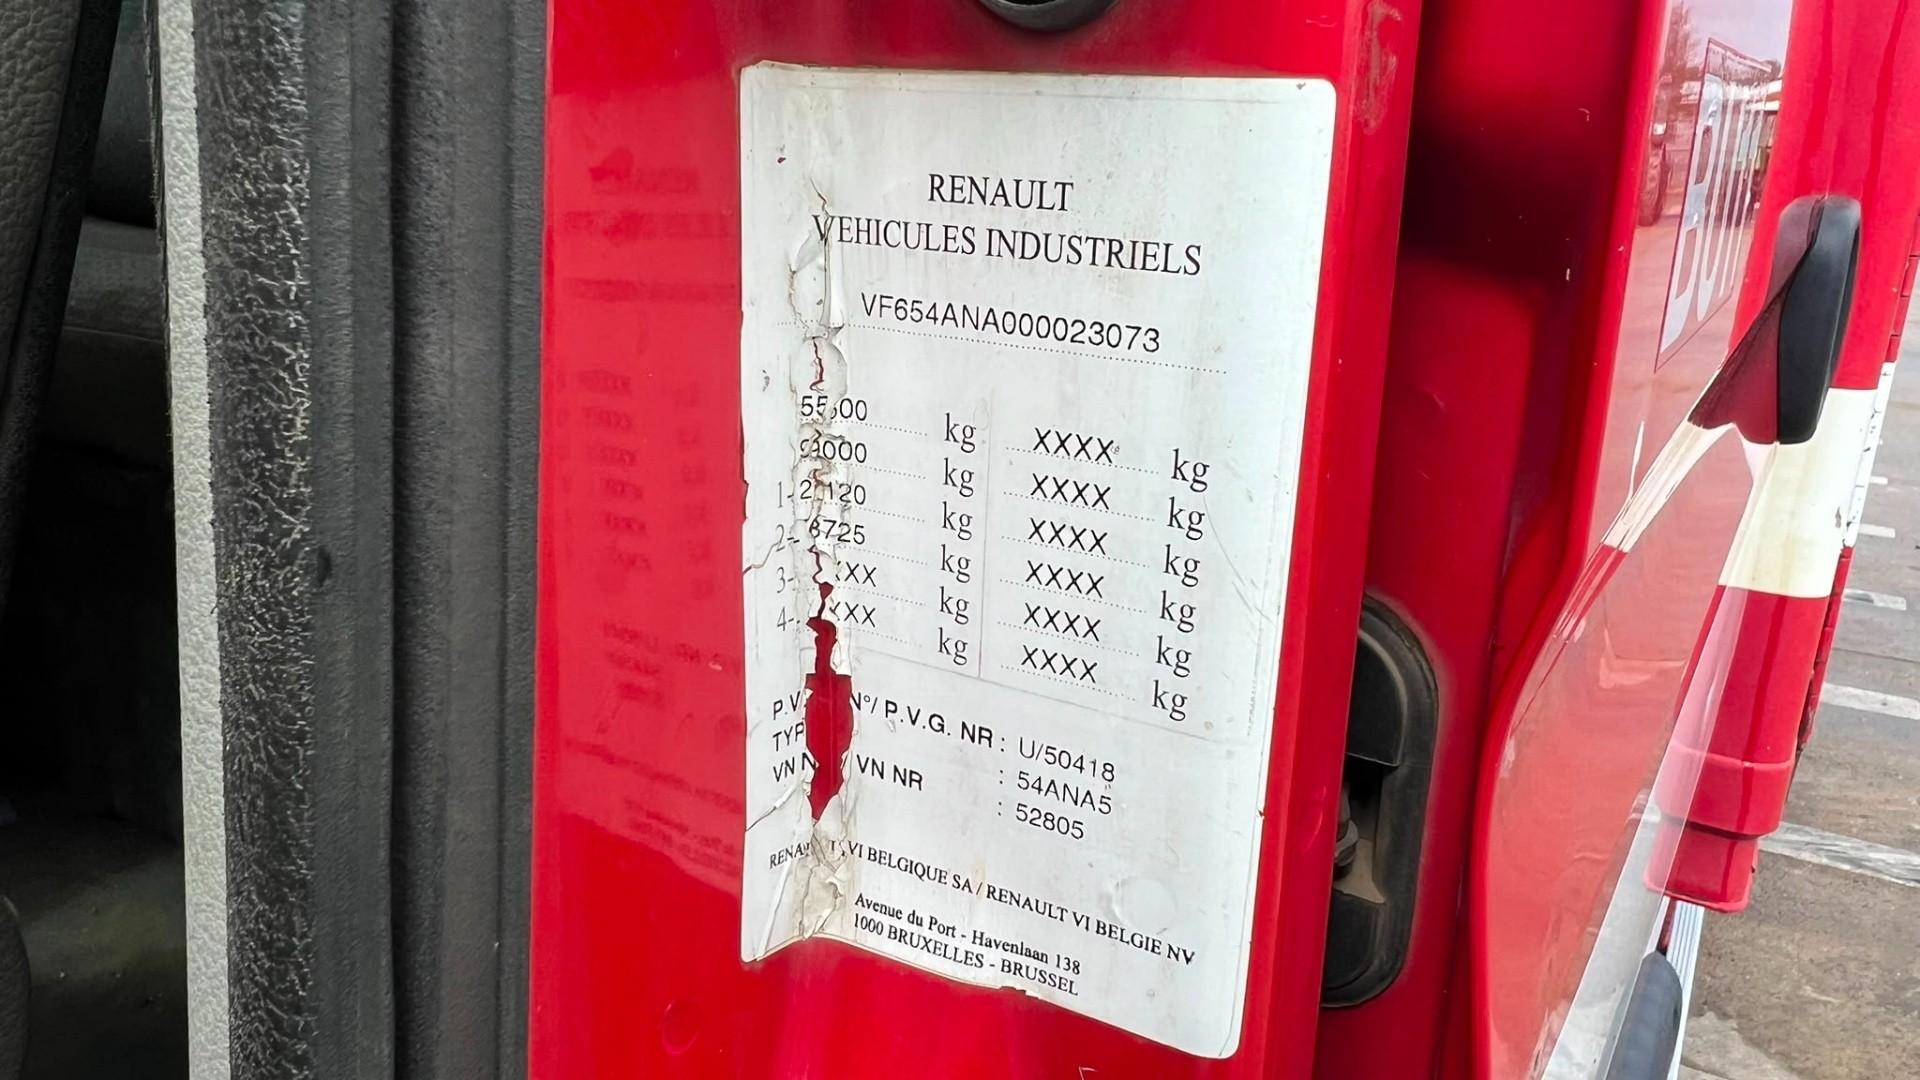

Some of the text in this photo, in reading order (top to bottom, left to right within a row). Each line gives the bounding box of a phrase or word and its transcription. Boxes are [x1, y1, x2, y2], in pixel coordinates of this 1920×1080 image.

[928, 173, 1074, 212] RENAULT
[812, 215, 1202, 276] VEHICULES INDUSTRIELS
[861, 292, 1160, 352] VF654ANA000023073
[945, 413, 976, 453] kg
[1033, 428, 1210, 492] XXXX kg
[943, 458, 975, 497] kg
[1030, 473, 1205, 540] XXXX kg
[800, 479, 866, 506] 2120
[942, 502, 973, 541] kg
[940, 545, 972, 583] kg
[1027, 517, 1201, 588] XXXX kg
[939, 587, 970, 625] kg
[1026, 560, 1197, 633] XXXX kg
[937, 628, 969, 666] kg
[1023, 602, 1192, 679] XXXX kg
[1021, 645, 1188, 723] XXXX kg
[884, 699, 952, 736] P.V.G.
[1018, 736, 1116, 783] U/50418
[857, 754, 885, 779] VN
[892, 766, 923, 791] NR
[1016, 803, 1085, 840] 52805
[1016, 770, 1113, 815] 54ANA5
[854, 892, 903, 920] Avenue
[907, 909, 924, 927] du
[928, 915, 956, 938] Port
[971, 930, 1048, 964] Havenlaan
[1056, 954, 1080, 975] 138
[867, 846, 948, 885] BELGIQUE
[986, 884, 1068, 921] RENAULT
[1072, 912, 1090, 932] VI
[1095, 919, 1162, 955] BELGIE
[1166, 943, 1195, 965] NV
[854, 913, 884, 936] 1000
[888, 925, 984, 968] BRUXELLES
[1000, 958, 1079, 996] BRUSSEL
